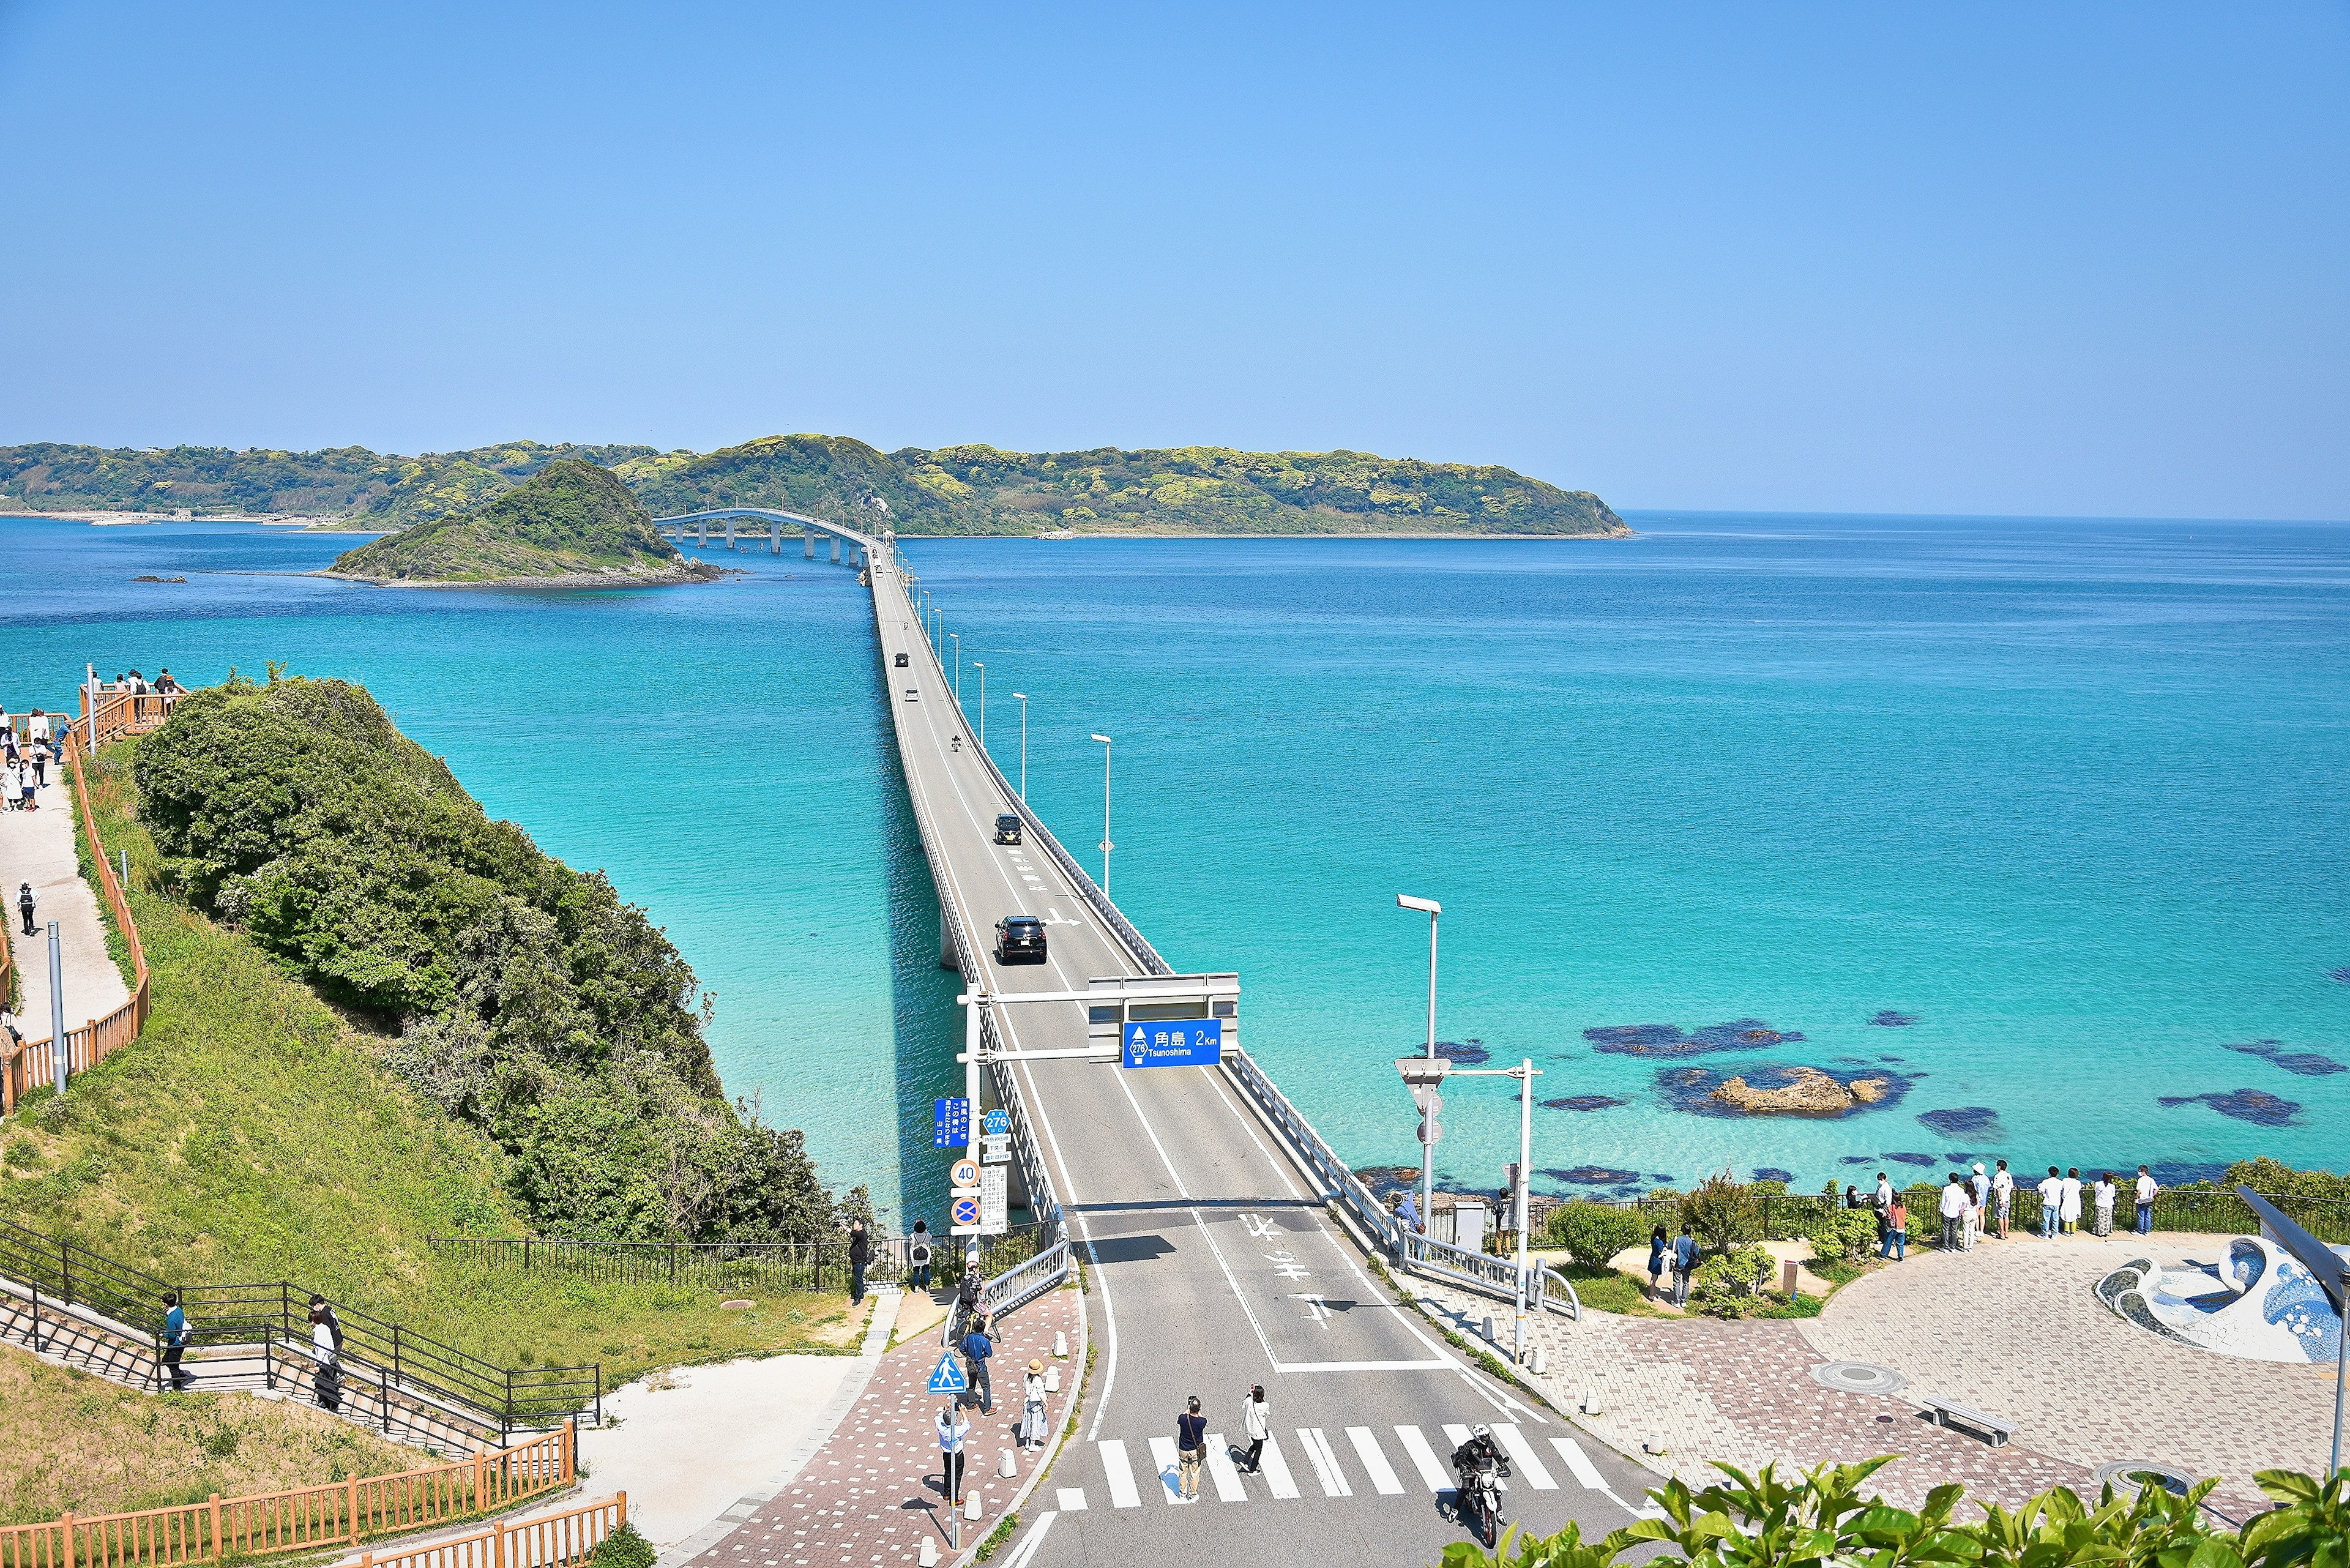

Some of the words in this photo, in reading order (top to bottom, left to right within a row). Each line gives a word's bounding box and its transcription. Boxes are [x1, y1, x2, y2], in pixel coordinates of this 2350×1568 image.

[1154, 1031, 1185, 1047] 角島
[1132, 1044, 1145, 1053] 276
[1148, 1048, 1192, 1057] Tsunoshima
[987, 1117, 1007, 1128] 276
[958, 1167, 974, 1179] 40
[1237, 1214, 1333, 1331] 止まれ
